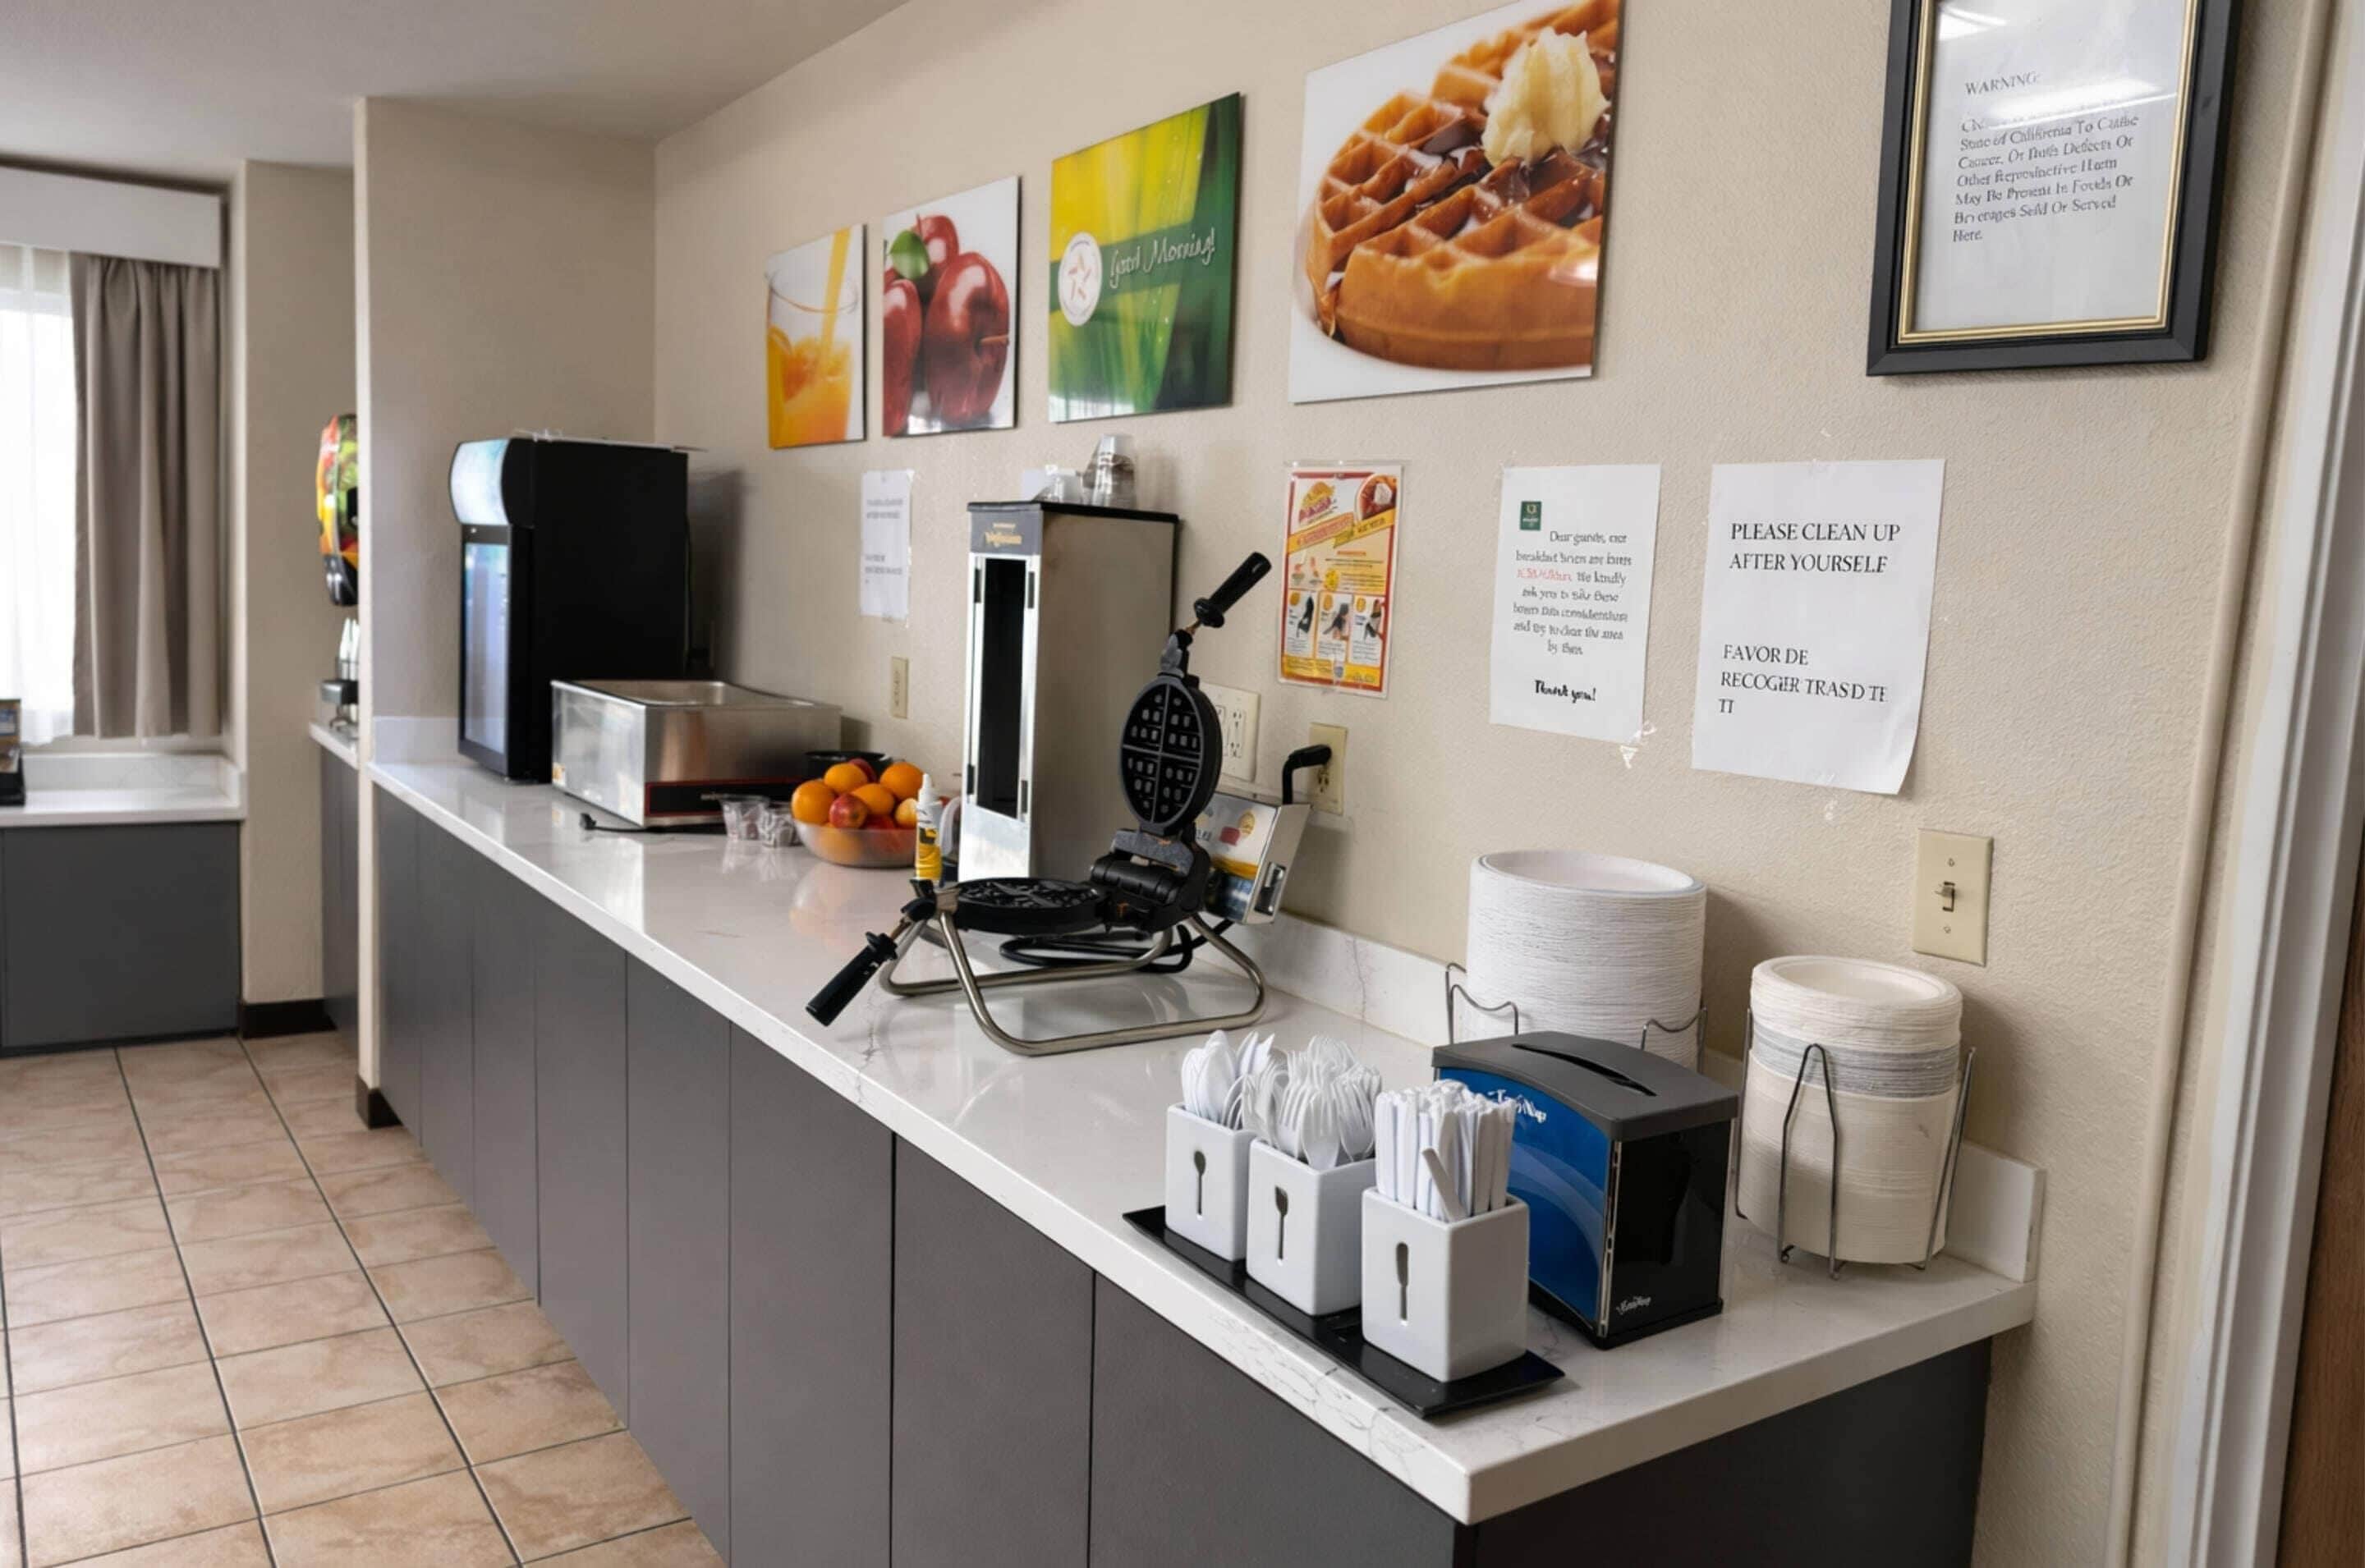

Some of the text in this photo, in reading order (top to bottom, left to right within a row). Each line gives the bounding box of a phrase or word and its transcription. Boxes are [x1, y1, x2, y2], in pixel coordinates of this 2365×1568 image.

[2077, 121, 2094, 134] To
[1730, 522, 1901, 542] PLEASE CLEAN UP
[1729, 552, 1889, 573] AFTER YOURSELF
[1724, 644, 1809, 666] FAVOR DE
[1535, 680, 1568, 697] Thank
